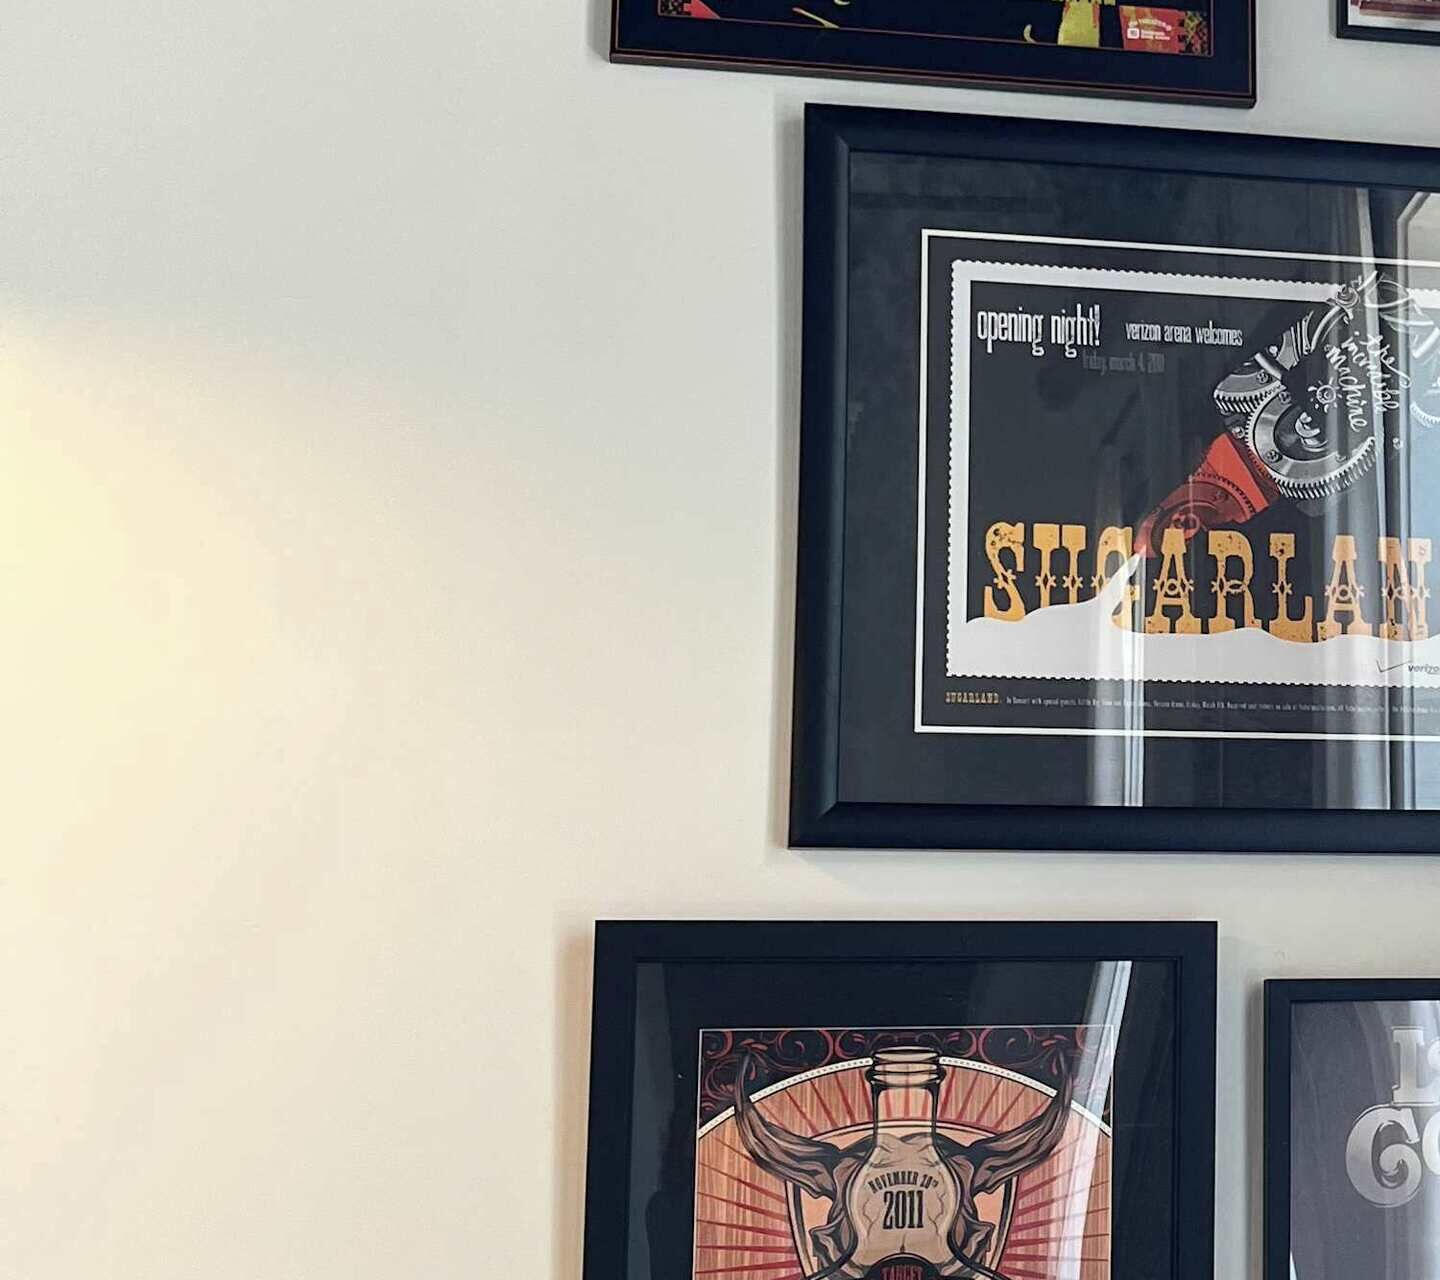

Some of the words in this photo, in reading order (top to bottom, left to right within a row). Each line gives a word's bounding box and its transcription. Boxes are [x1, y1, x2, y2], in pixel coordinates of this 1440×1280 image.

[977, 306, 1044, 357] opening
[1050, 303, 1100, 359] night!
[1126, 321, 1161, 342] verizon
[1164, 323, 1192, 343] arena
[1195, 320, 1243, 347] welcomes
[868, 1170, 919, 1194] NOVEMBER
[882, 1190, 924, 1230] 2011
